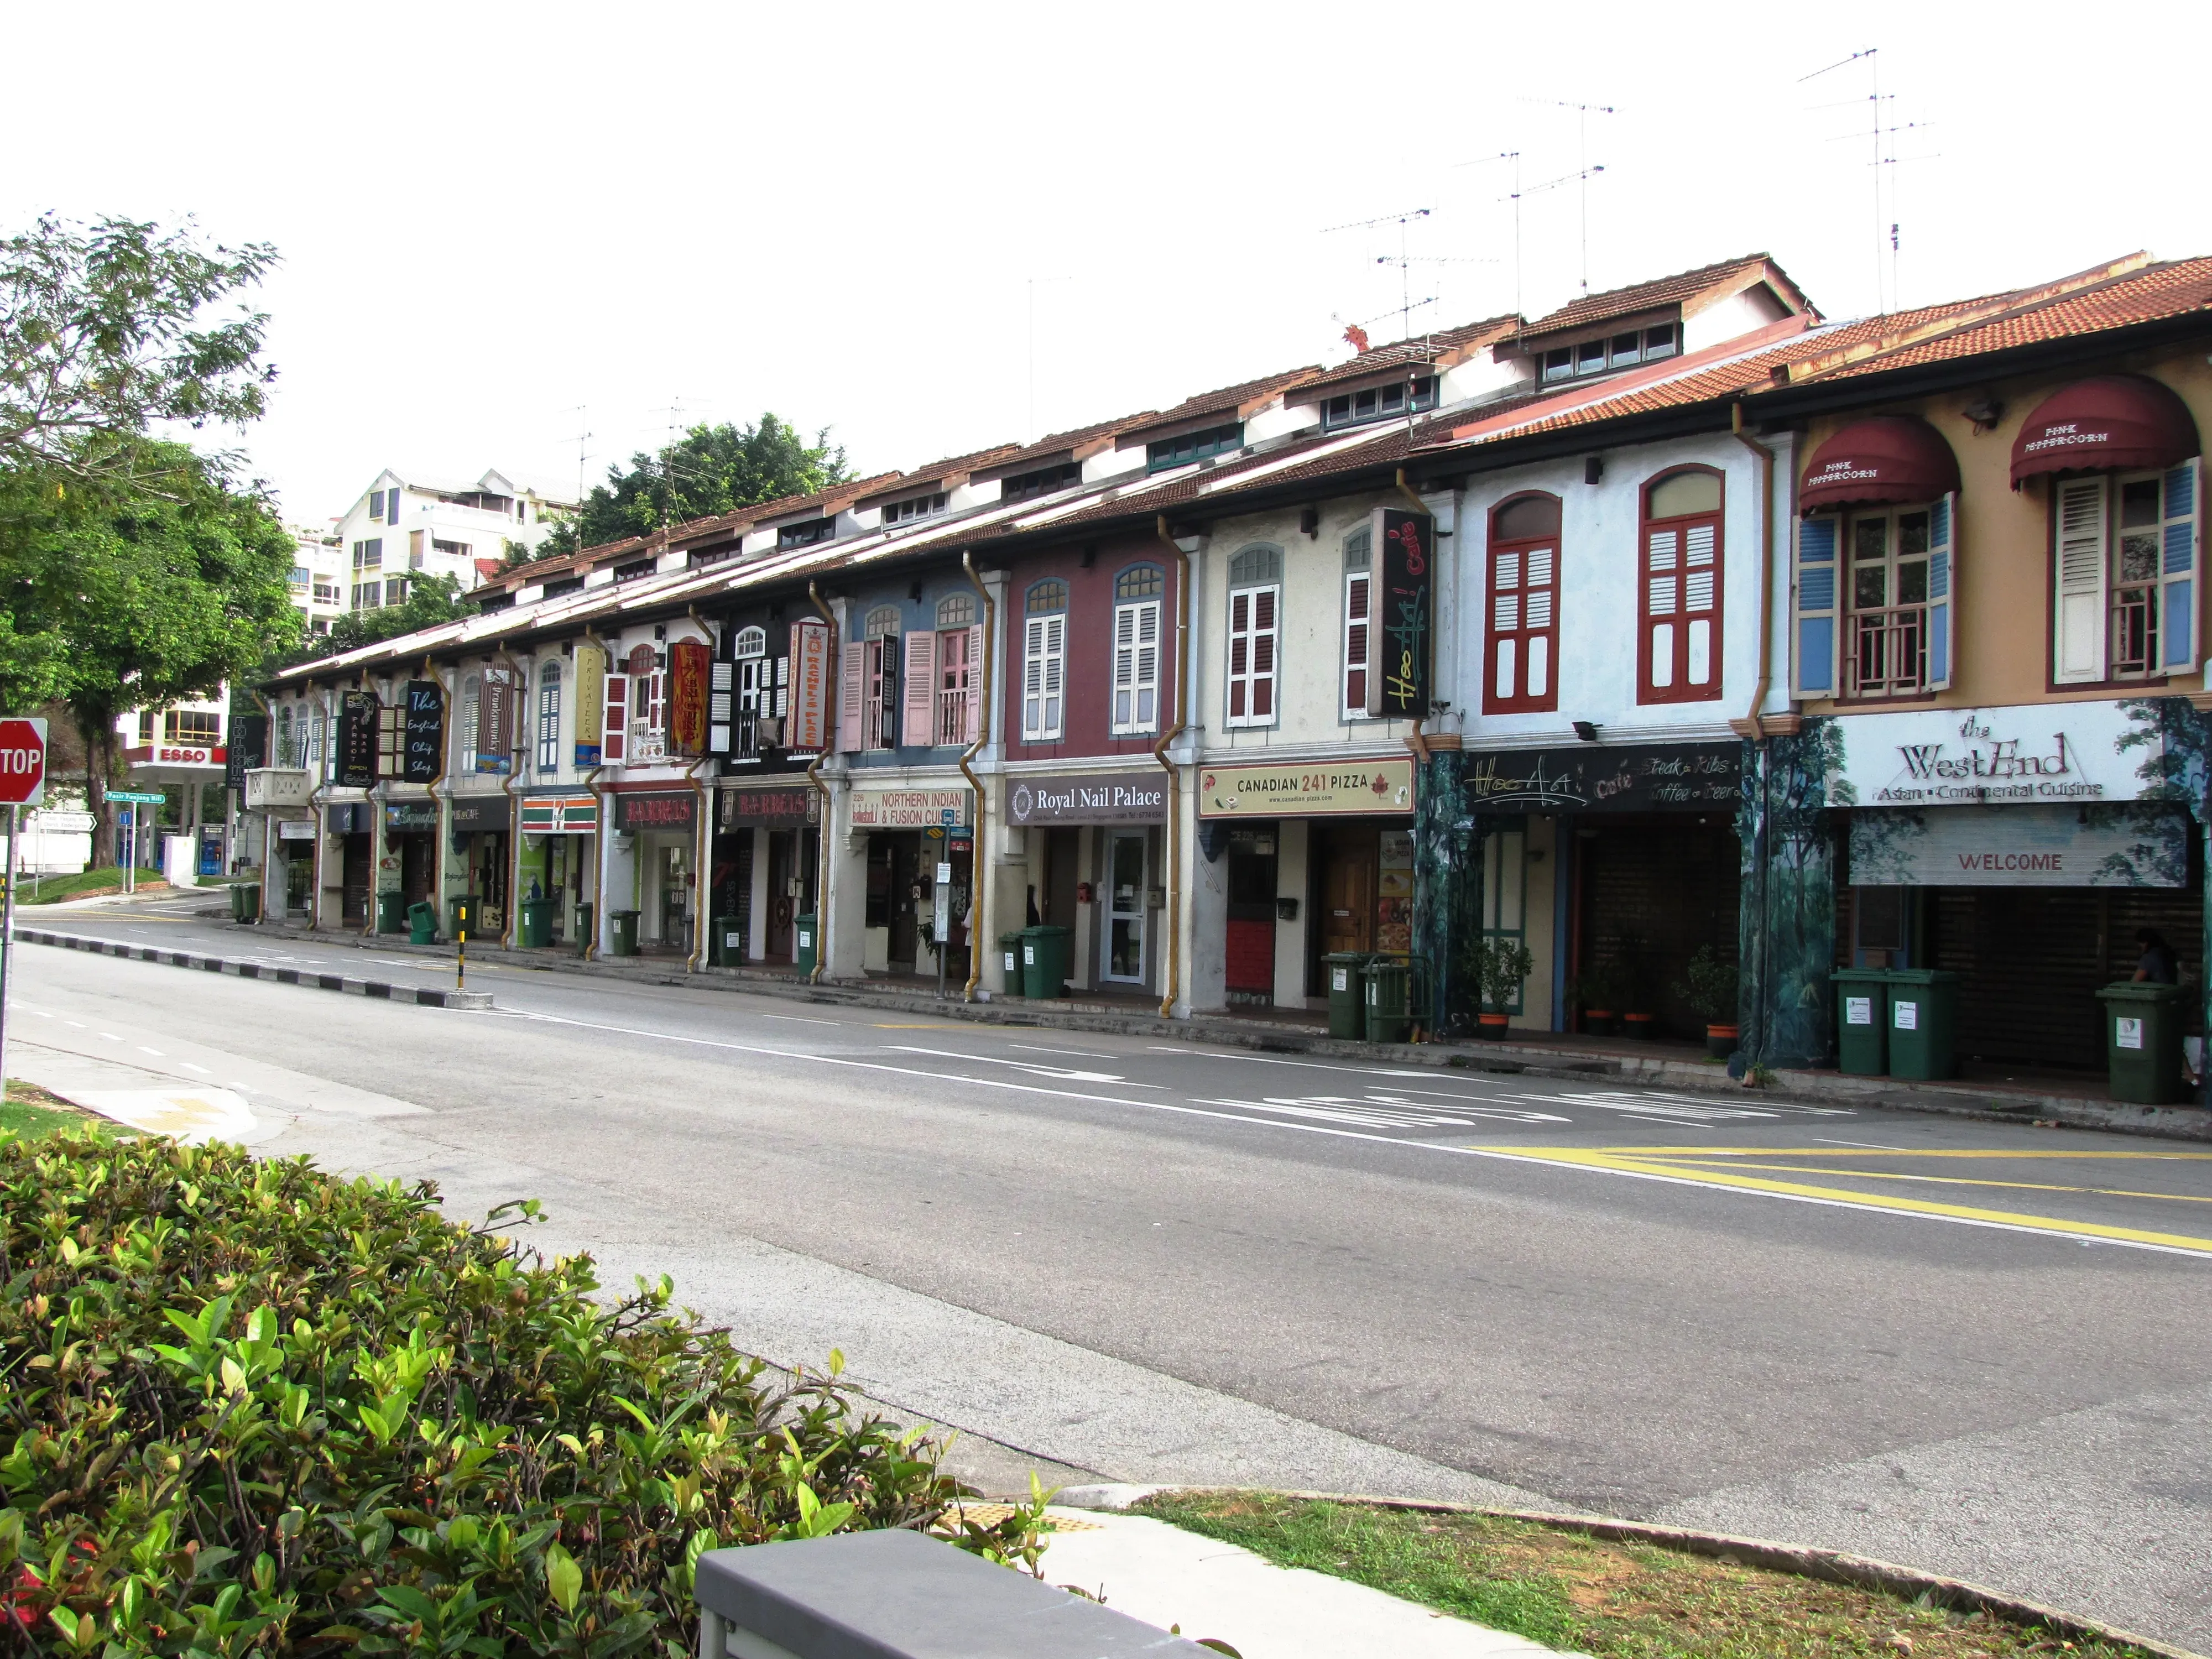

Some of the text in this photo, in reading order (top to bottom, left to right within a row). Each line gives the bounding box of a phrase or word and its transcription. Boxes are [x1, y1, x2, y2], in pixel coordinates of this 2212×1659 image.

[411, 691, 439, 712] The
[585, 658, 593, 734] PRIVATEER
[408, 719, 440, 733] English
[805, 711, 818, 745] PLACE
[1958, 715, 1990, 738] the
[350, 716, 358, 762] PARROT
[412, 742, 434, 755] Chip
[0, 749, 41, 774] TOP
[160, 749, 206, 763] ESSO
[1642, 755, 1730, 776] Steak Ribs
[1895, 732, 2069, 780] West End
[411, 761, 433, 775] Shop
[1237, 774, 1368, 792] CANADIAN 241 PIZZA
[1877, 781, 2103, 801] Asian Continental Cuisine
[881, 792, 962, 807] NORTHERN INDIAN
[1037, 786, 1161, 815] Royal Nail Palace
[881, 810, 961, 824] & FUSION CUISE
[1958, 853, 2063, 870] WELCOME
